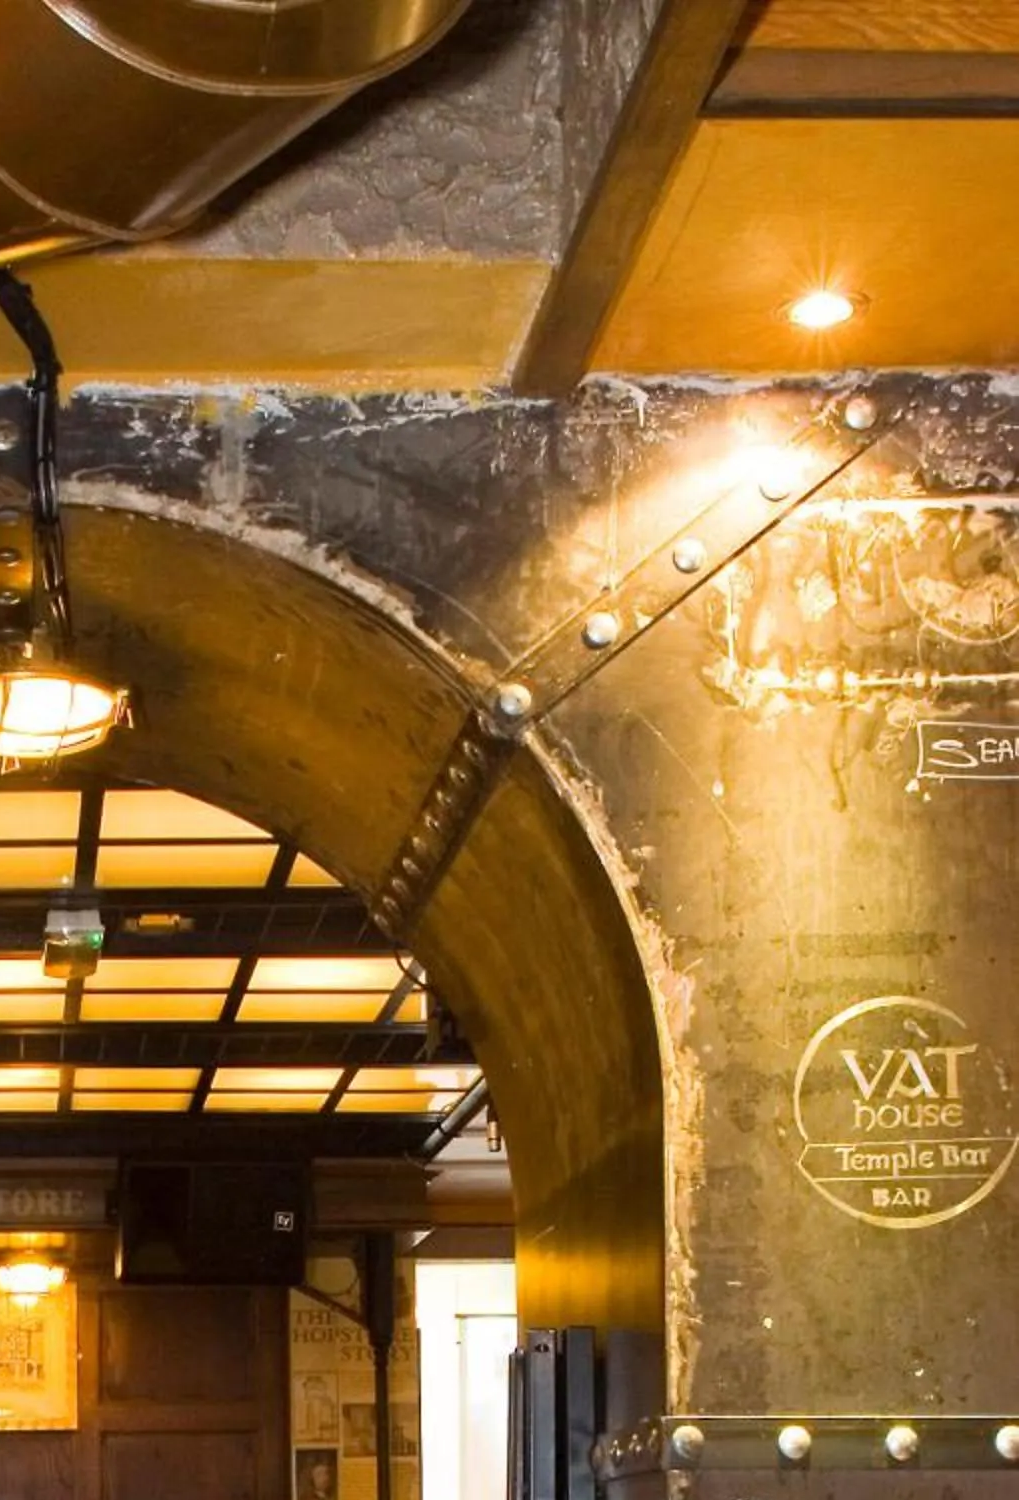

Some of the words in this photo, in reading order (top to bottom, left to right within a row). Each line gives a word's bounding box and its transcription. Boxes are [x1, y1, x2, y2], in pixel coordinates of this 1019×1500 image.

[928, 738, 1019, 768] SEA
[840, 1043, 979, 1101] VAT
[834, 1140, 934, 1179] Temple
[939, 1145, 991, 1167] Bar
[872, 1187, 930, 1207] BAR
[292, 1326, 414, 1342] HOPSTE
